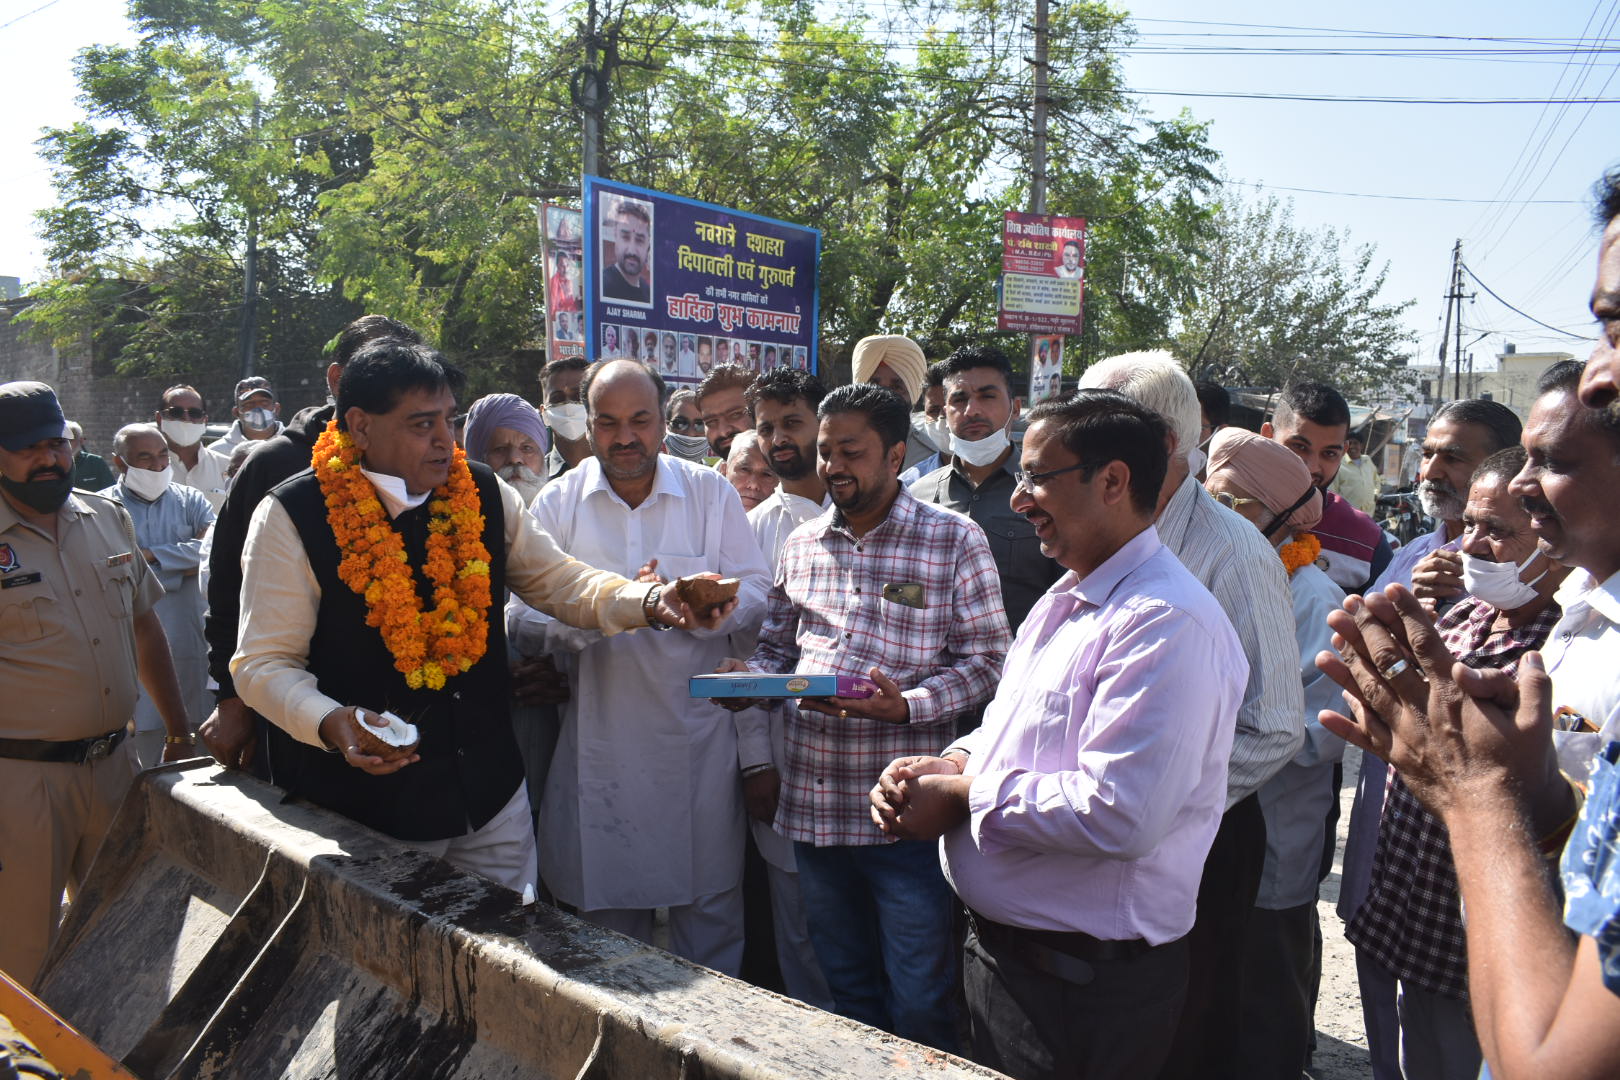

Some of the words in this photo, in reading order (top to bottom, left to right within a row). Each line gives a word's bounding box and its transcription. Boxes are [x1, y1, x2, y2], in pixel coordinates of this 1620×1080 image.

[695, 221, 736, 247] नवरात्रे
[746, 232, 785, 257] दशहरा
[677, 245, 734, 278] दिपावली
[737, 259, 755, 281] एवं
[606, 306, 621, 317] AJAY
[622, 308, 647, 320] SHARMA
[667, 293, 715, 322] हार्दिक
[717, 303, 744, 332] शुभ
